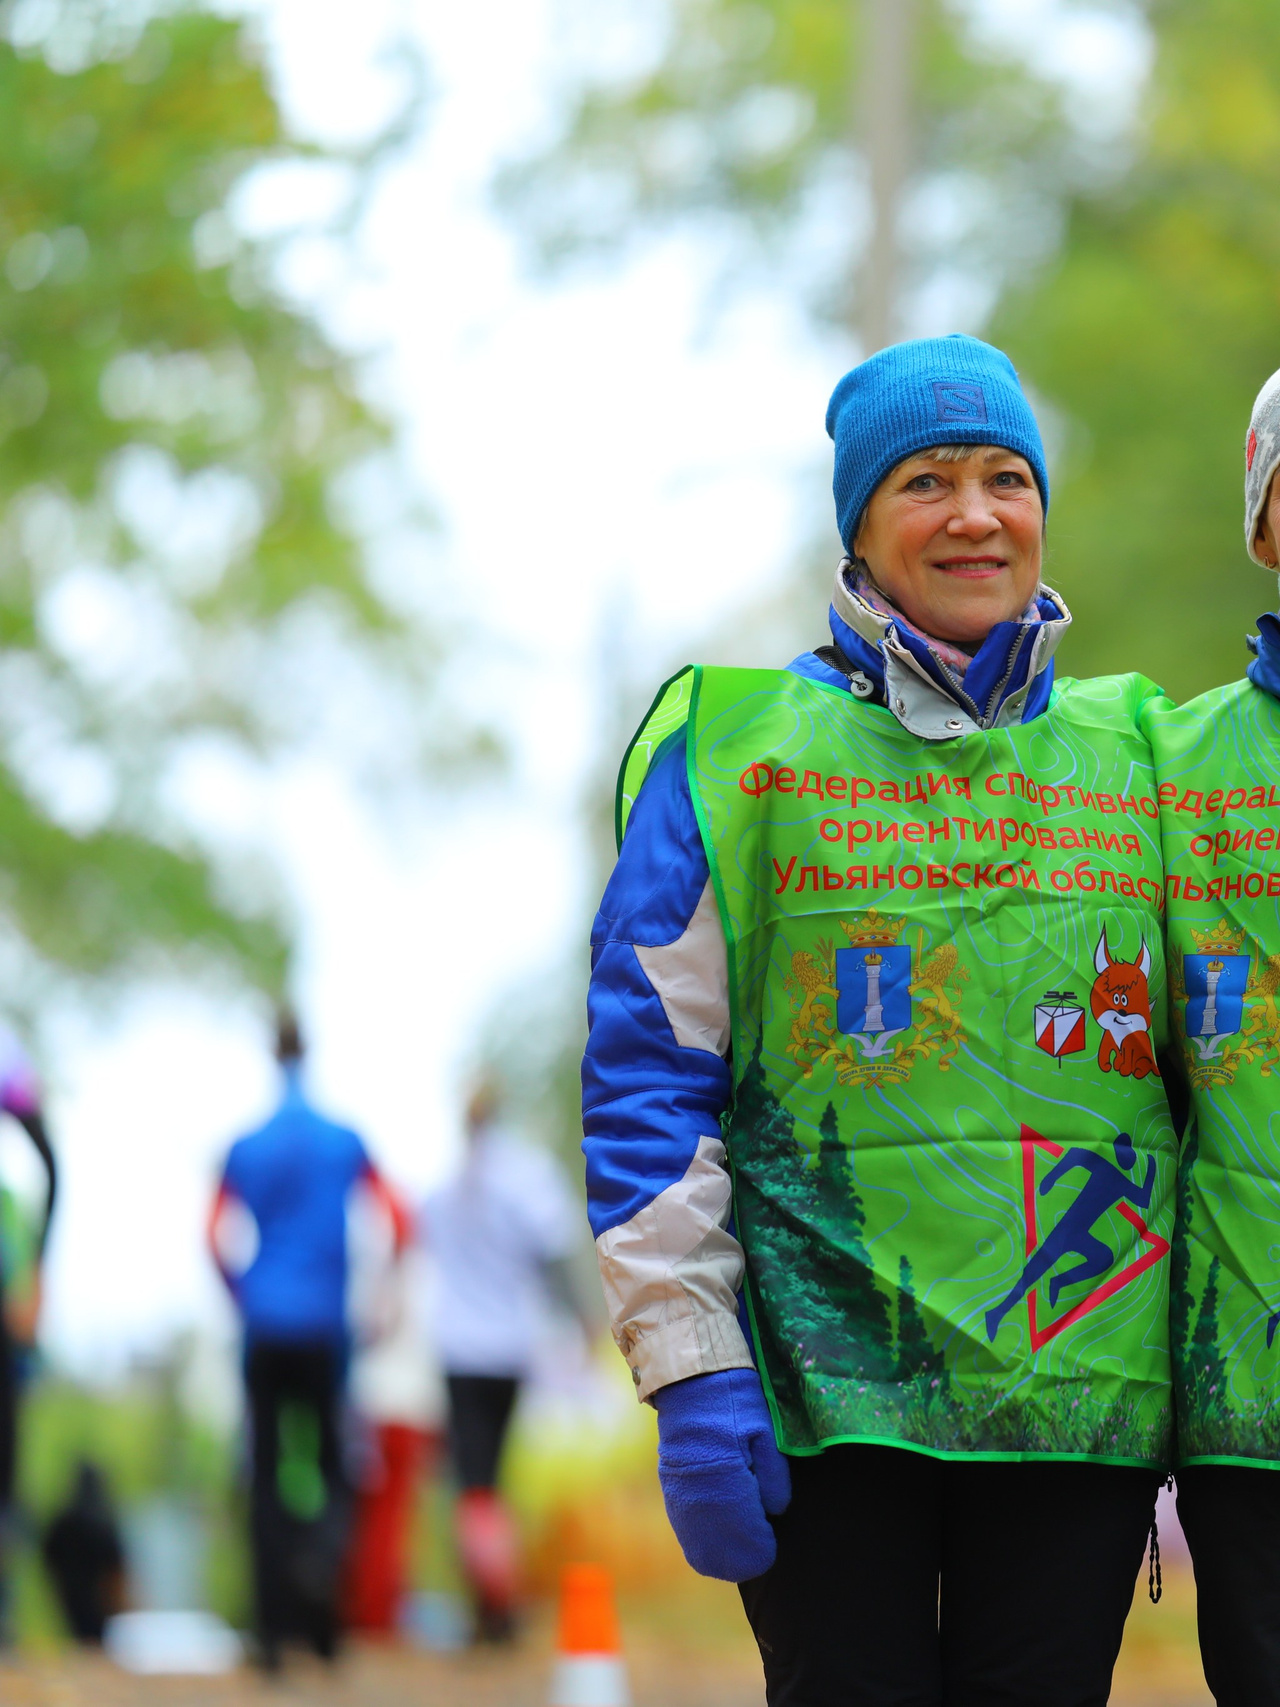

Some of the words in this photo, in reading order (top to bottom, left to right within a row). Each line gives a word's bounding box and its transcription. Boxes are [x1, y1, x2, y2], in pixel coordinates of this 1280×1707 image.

[738, 761, 972, 808] Федерация
[984, 772, 1159, 819] спортивно
[819, 816, 1143, 857] ориентирования
[772, 856, 1041, 895] Ульяновской
